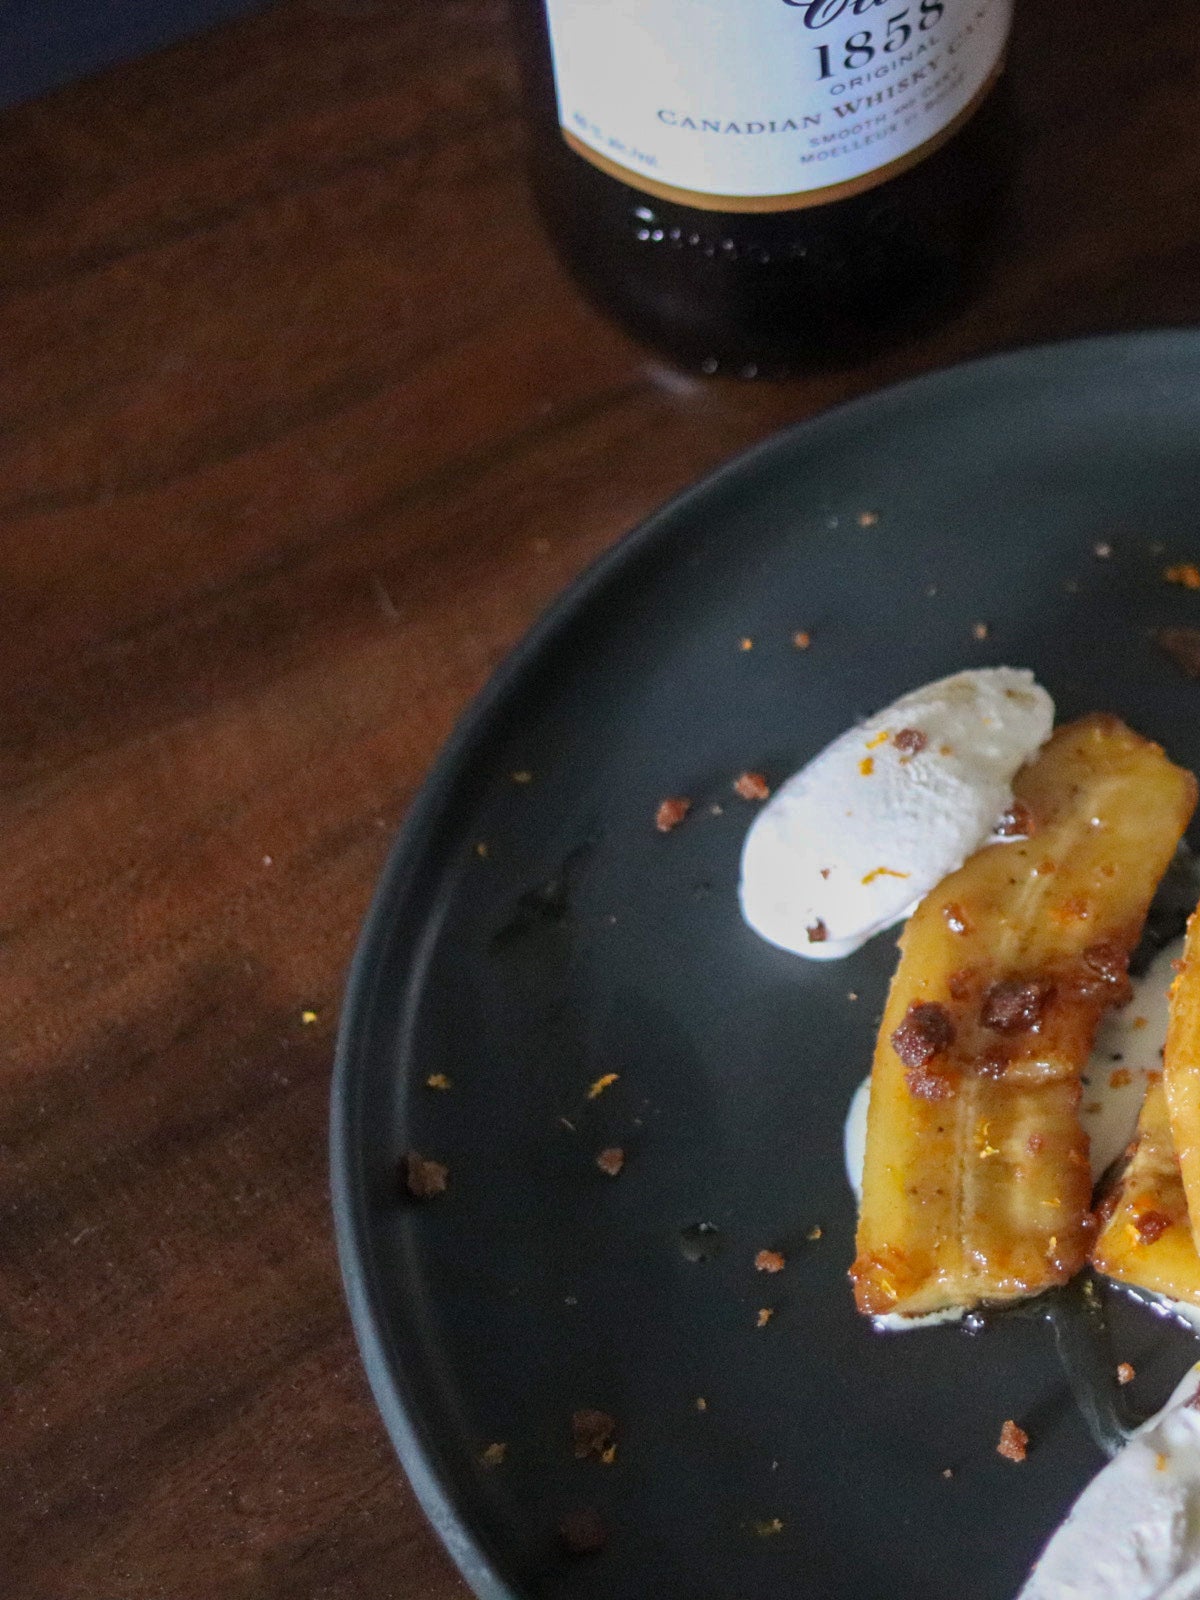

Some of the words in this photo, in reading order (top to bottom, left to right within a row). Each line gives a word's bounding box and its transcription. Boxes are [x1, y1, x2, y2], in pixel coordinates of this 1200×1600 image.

[813, 0, 945, 80] 1858
[829, 34, 940, 96] ORIGINAL
[656, 109, 822, 135] CANADIAN
[832, 53, 942, 119] WHISKY
[809, 113, 888, 148] SMOOTH
